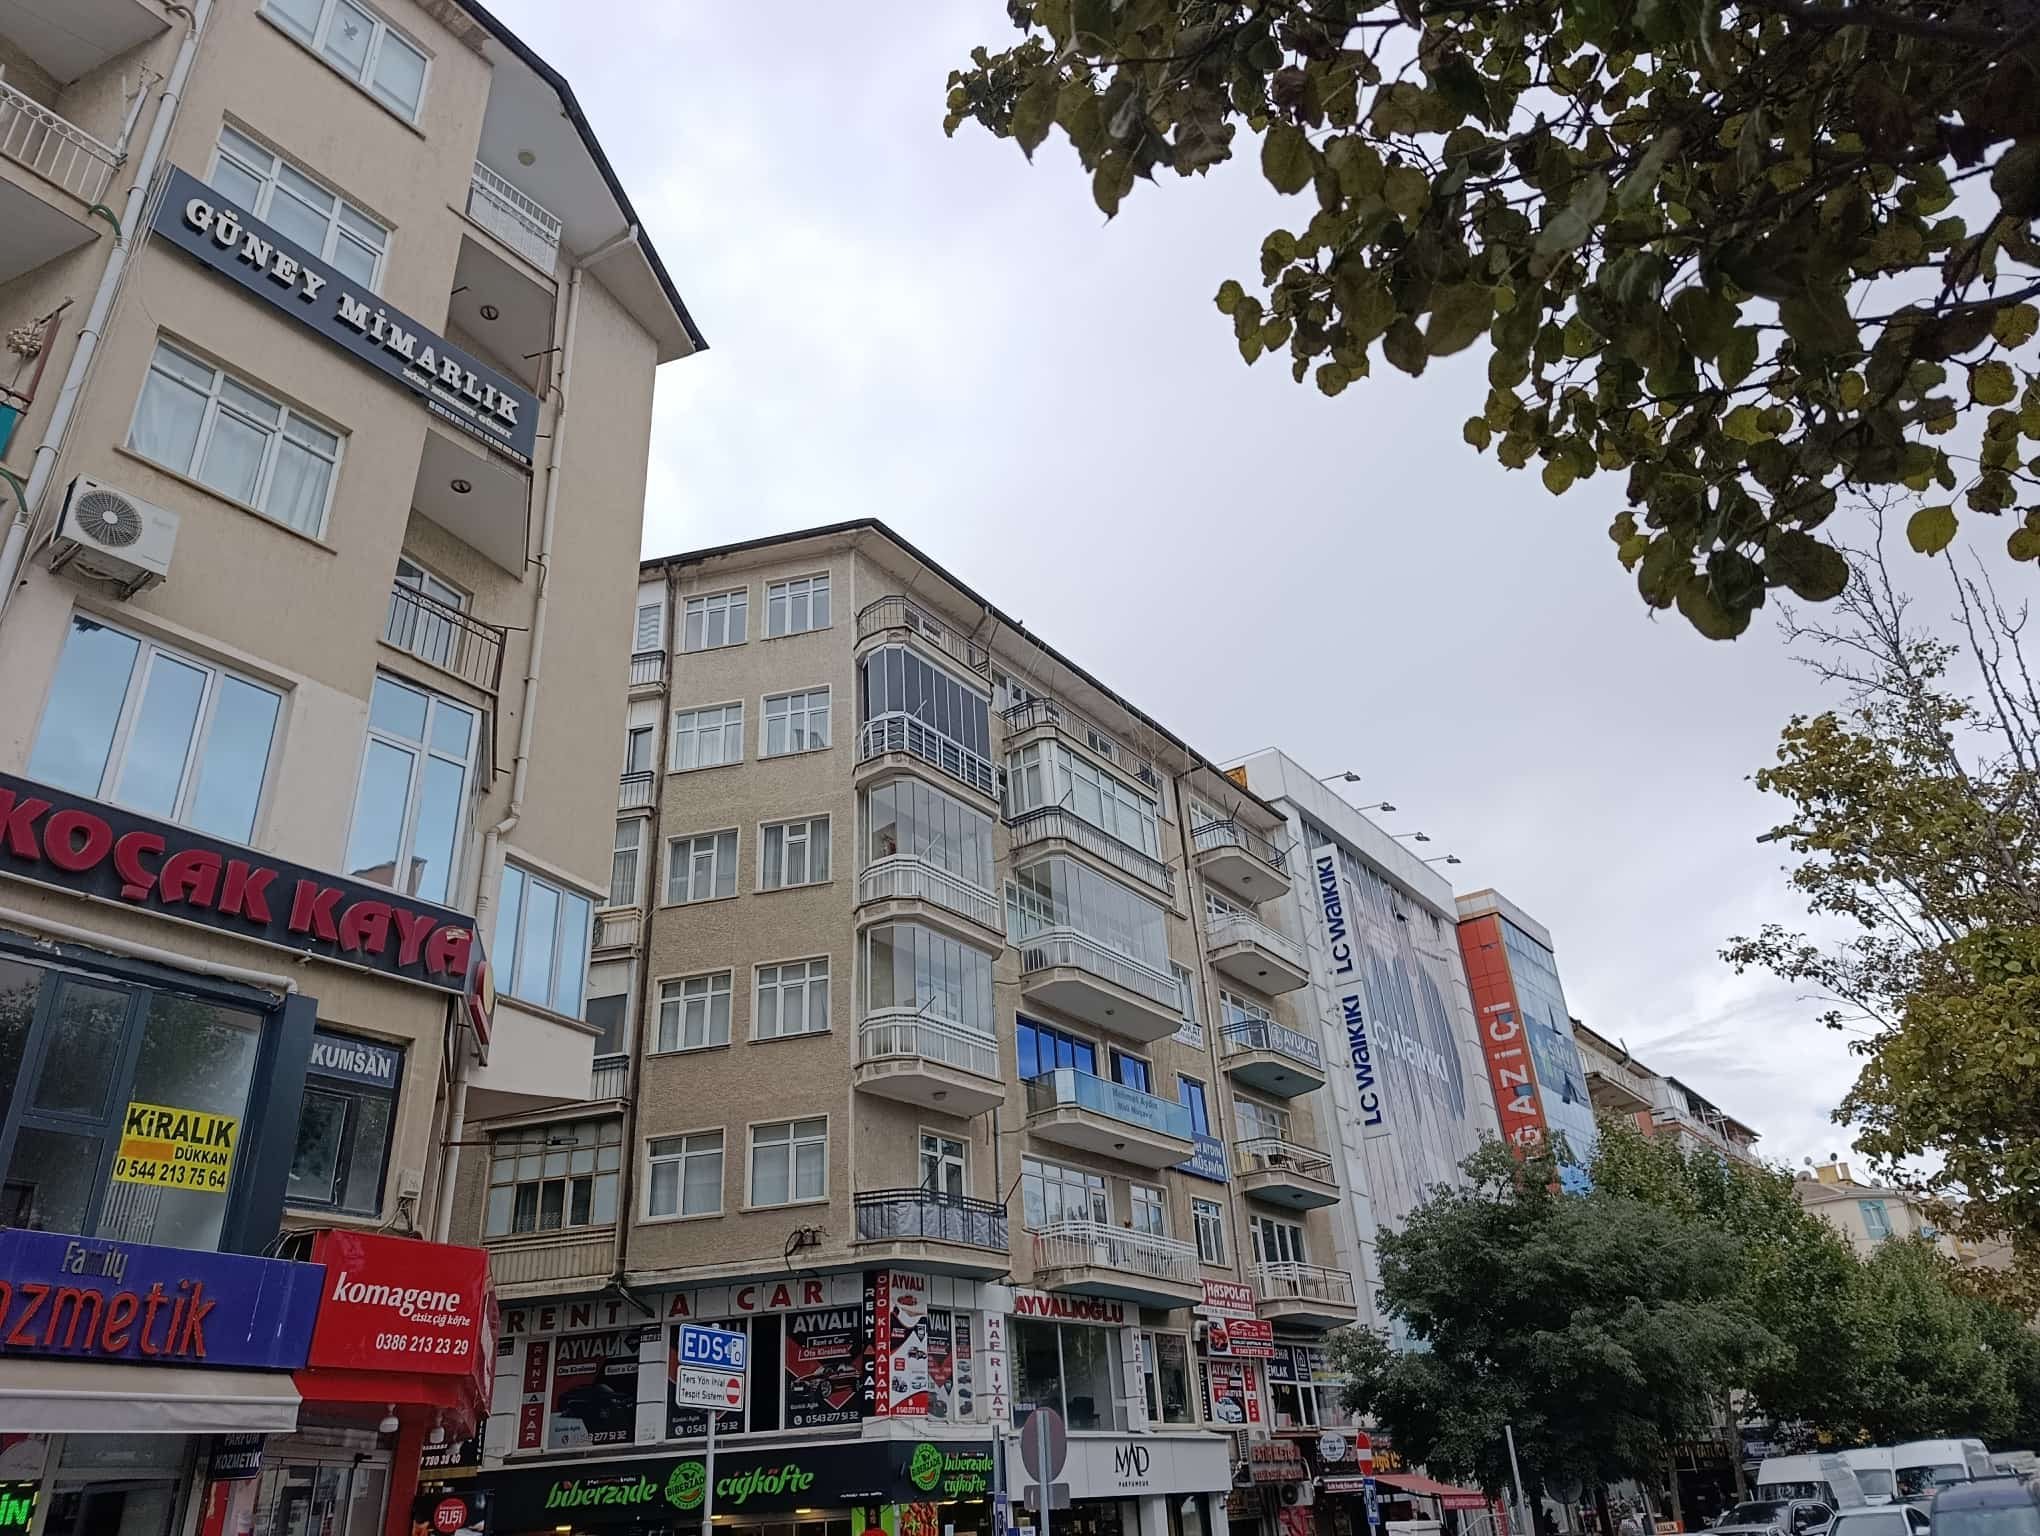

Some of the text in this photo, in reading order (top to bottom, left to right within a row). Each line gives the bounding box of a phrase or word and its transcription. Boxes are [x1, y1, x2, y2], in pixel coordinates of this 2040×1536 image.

[185, 198, 521, 425] GÜNEY MİMARLIK
[0, 788, 474, 977] KOÇAK KAYA
[310, 1042, 392, 1079] KUMSAN
[174, 1145, 228, 1166] DÜKKAN
[116, 1158, 226, 1188] 0 544 213 75 64
[333, 1271, 461, 1318] komagene
[892, 1274, 925, 1292] AYVALI
[507, 1279, 824, 1333] RENT A CAR
[1014, 1295, 1125, 1323] AYVALIOĞLU
[793, 1311, 859, 1334] AYVALI
[375, 1333, 469, 1356] 0386 213 23 29
[684, 1332, 724, 1361] EDS
[682, 1373, 697, 1385] Ters
[697, 1375, 710, 1386] Yön
[864, 1361, 876, 1401] CAR
[1267, 1364, 1289, 1378] EMLAK
[682, 1388, 701, 1400] Tespit
[944, 1452, 994, 1472] biberzade
[1114, 1439, 1150, 1478] MAD
[545, 1474, 659, 1509] biberzade
[716, 1462, 816, 1505] çiğköfte
